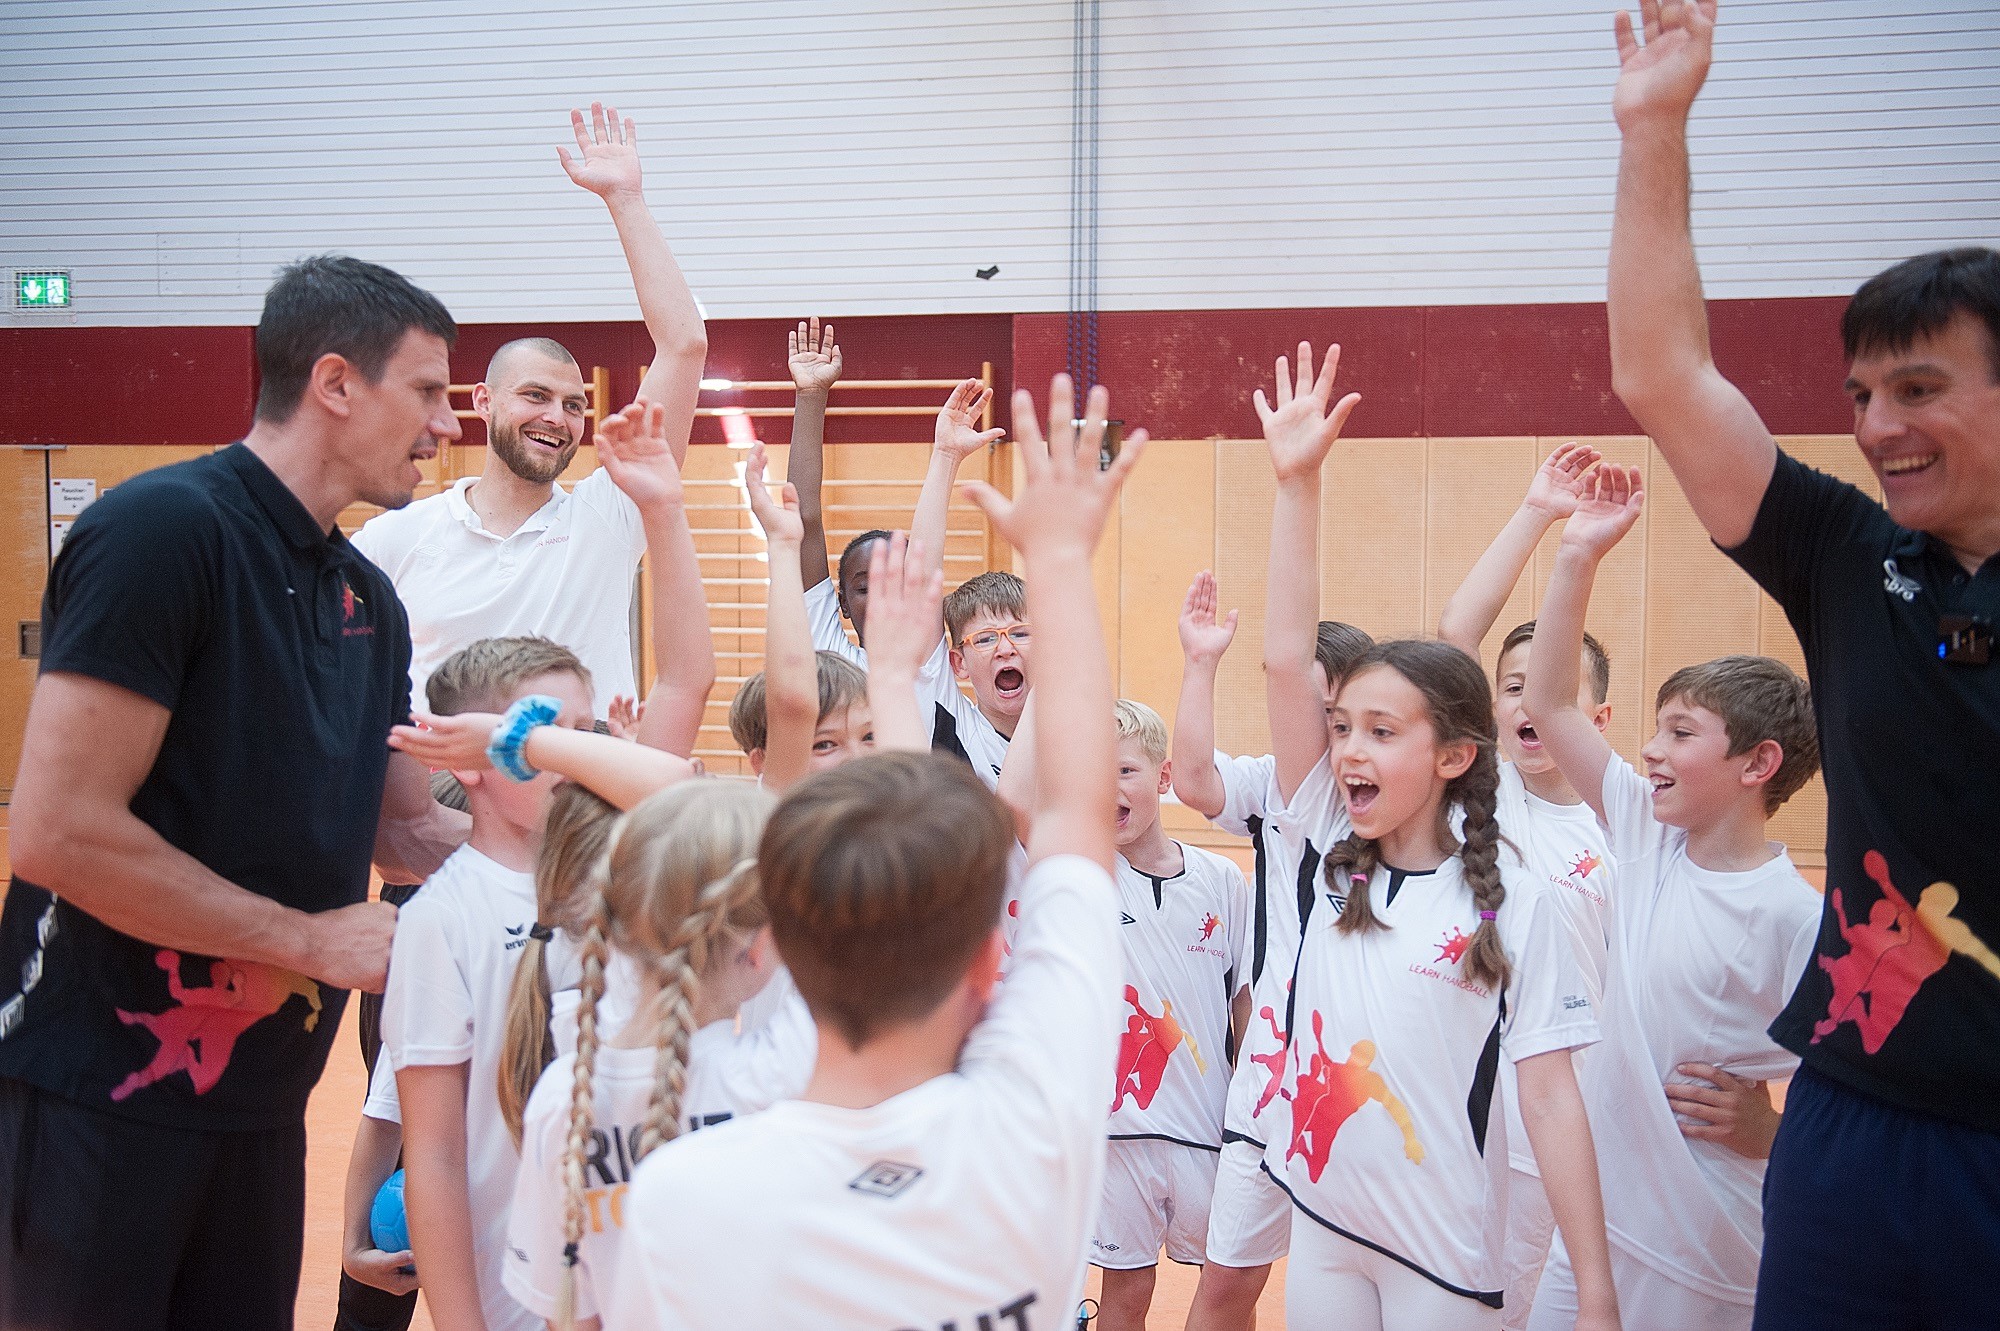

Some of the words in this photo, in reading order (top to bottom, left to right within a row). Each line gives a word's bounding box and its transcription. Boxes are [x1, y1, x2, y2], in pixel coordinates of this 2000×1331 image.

[1549, 874, 1574, 890] LEARN
[1186, 944, 1206, 953] LEARN
[1408, 963, 1441, 979] LEARN
[1442, 973, 1488, 999] HANDBALL
